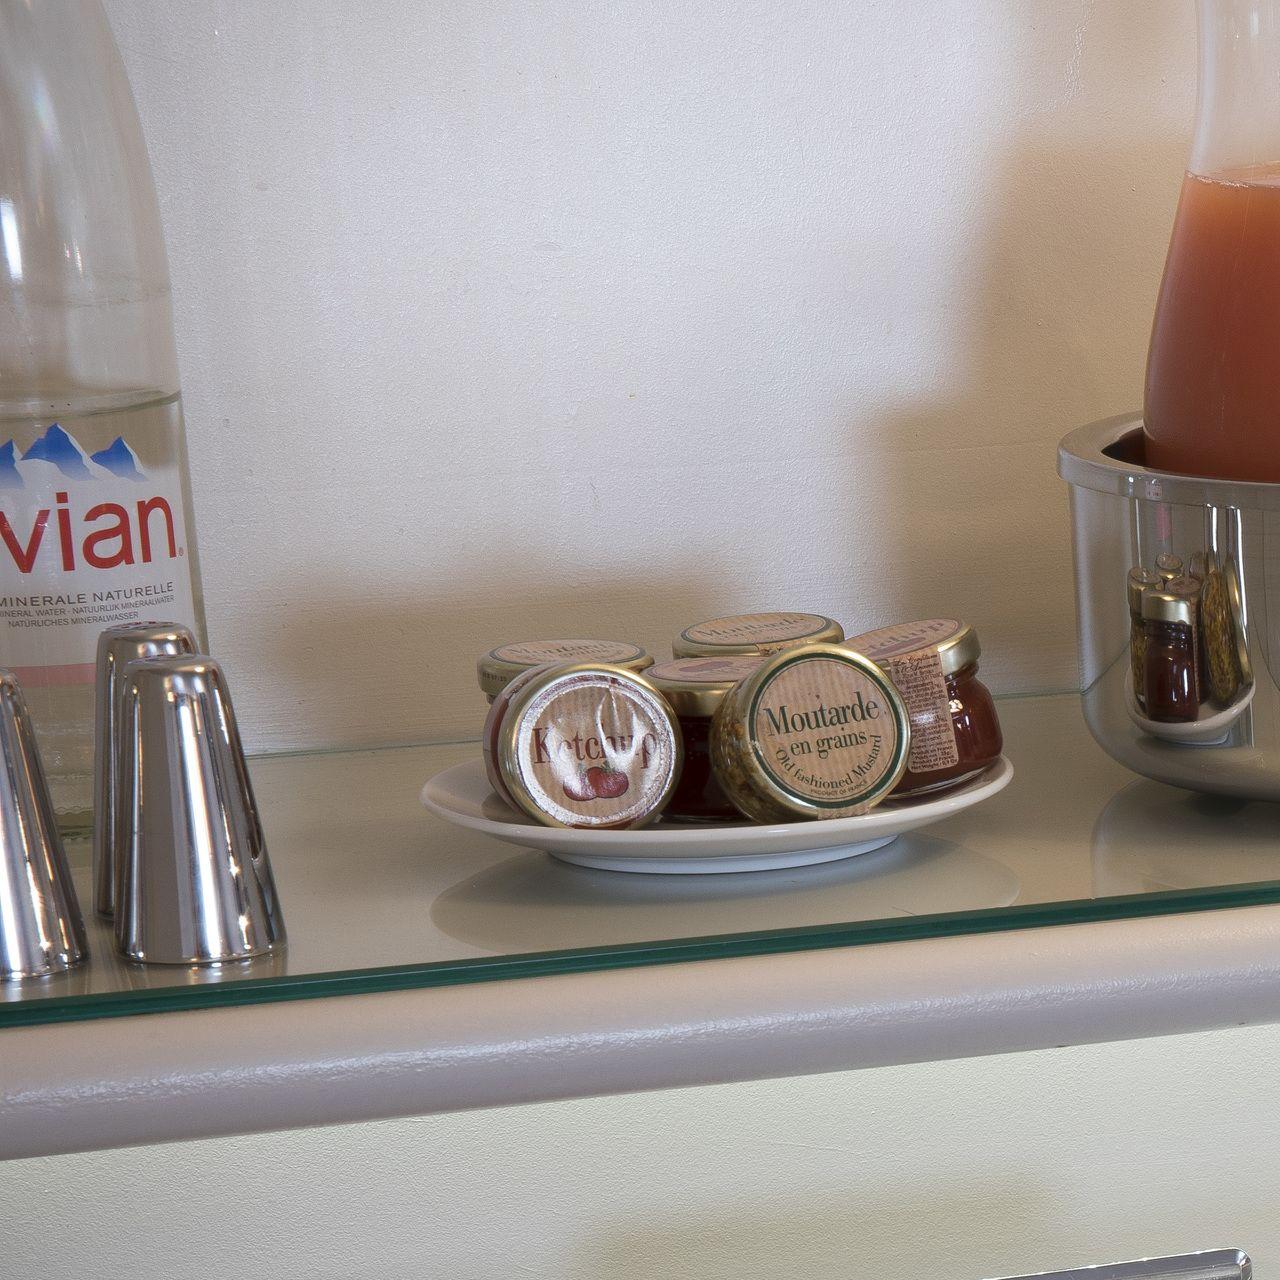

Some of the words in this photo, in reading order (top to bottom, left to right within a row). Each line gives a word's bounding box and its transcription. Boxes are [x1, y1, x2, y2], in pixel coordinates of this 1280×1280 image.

[0, 492, 177, 573] vian
[93, 581, 174, 602] NATURELLE
[36, 608, 65, 617] WATER
[71, 611, 139, 625] MINERALWASSER
[763, 691, 880, 736] Moutarde
[790, 740, 812, 756] en
[816, 727, 868, 759] grains
[775, 747, 795, 772] Old
[794, 767, 853, 789] fashioned
[851, 735, 882, 778] Mustard
